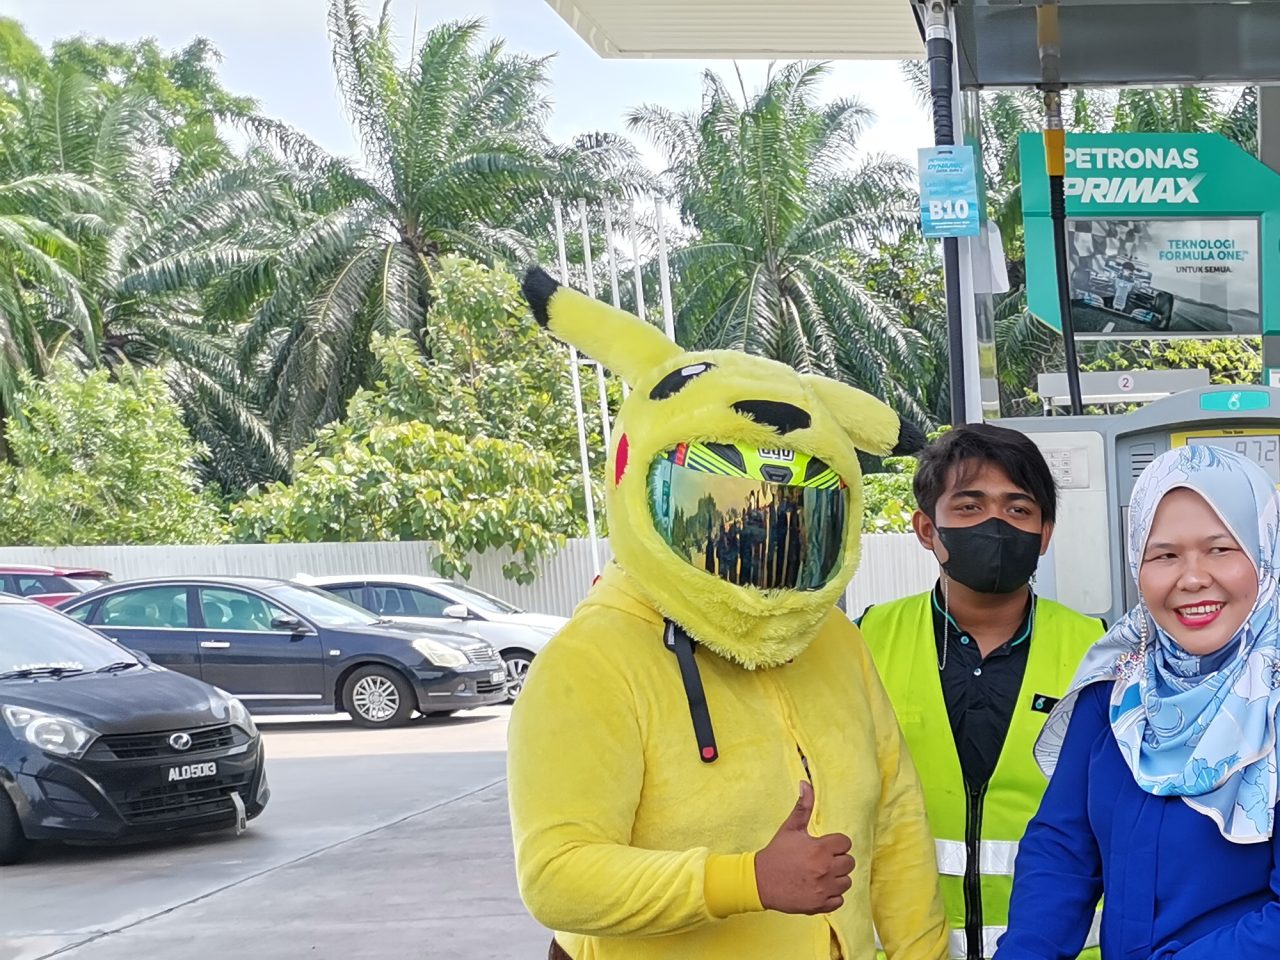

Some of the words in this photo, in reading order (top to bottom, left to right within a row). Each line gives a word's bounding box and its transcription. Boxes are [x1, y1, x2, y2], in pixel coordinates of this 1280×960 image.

[1064, 148, 1199, 169] PETRONAS
[1064, 172, 1207, 204] PRIMAX
[929, 199, 969, 220] B10
[1168, 239, 1236, 249] TEKNOLOGI
[1159, 251, 1215, 261] FORMULA
[1176, 266, 1203, 274] UNTUK
[1122, 378, 1129, 388] 2
